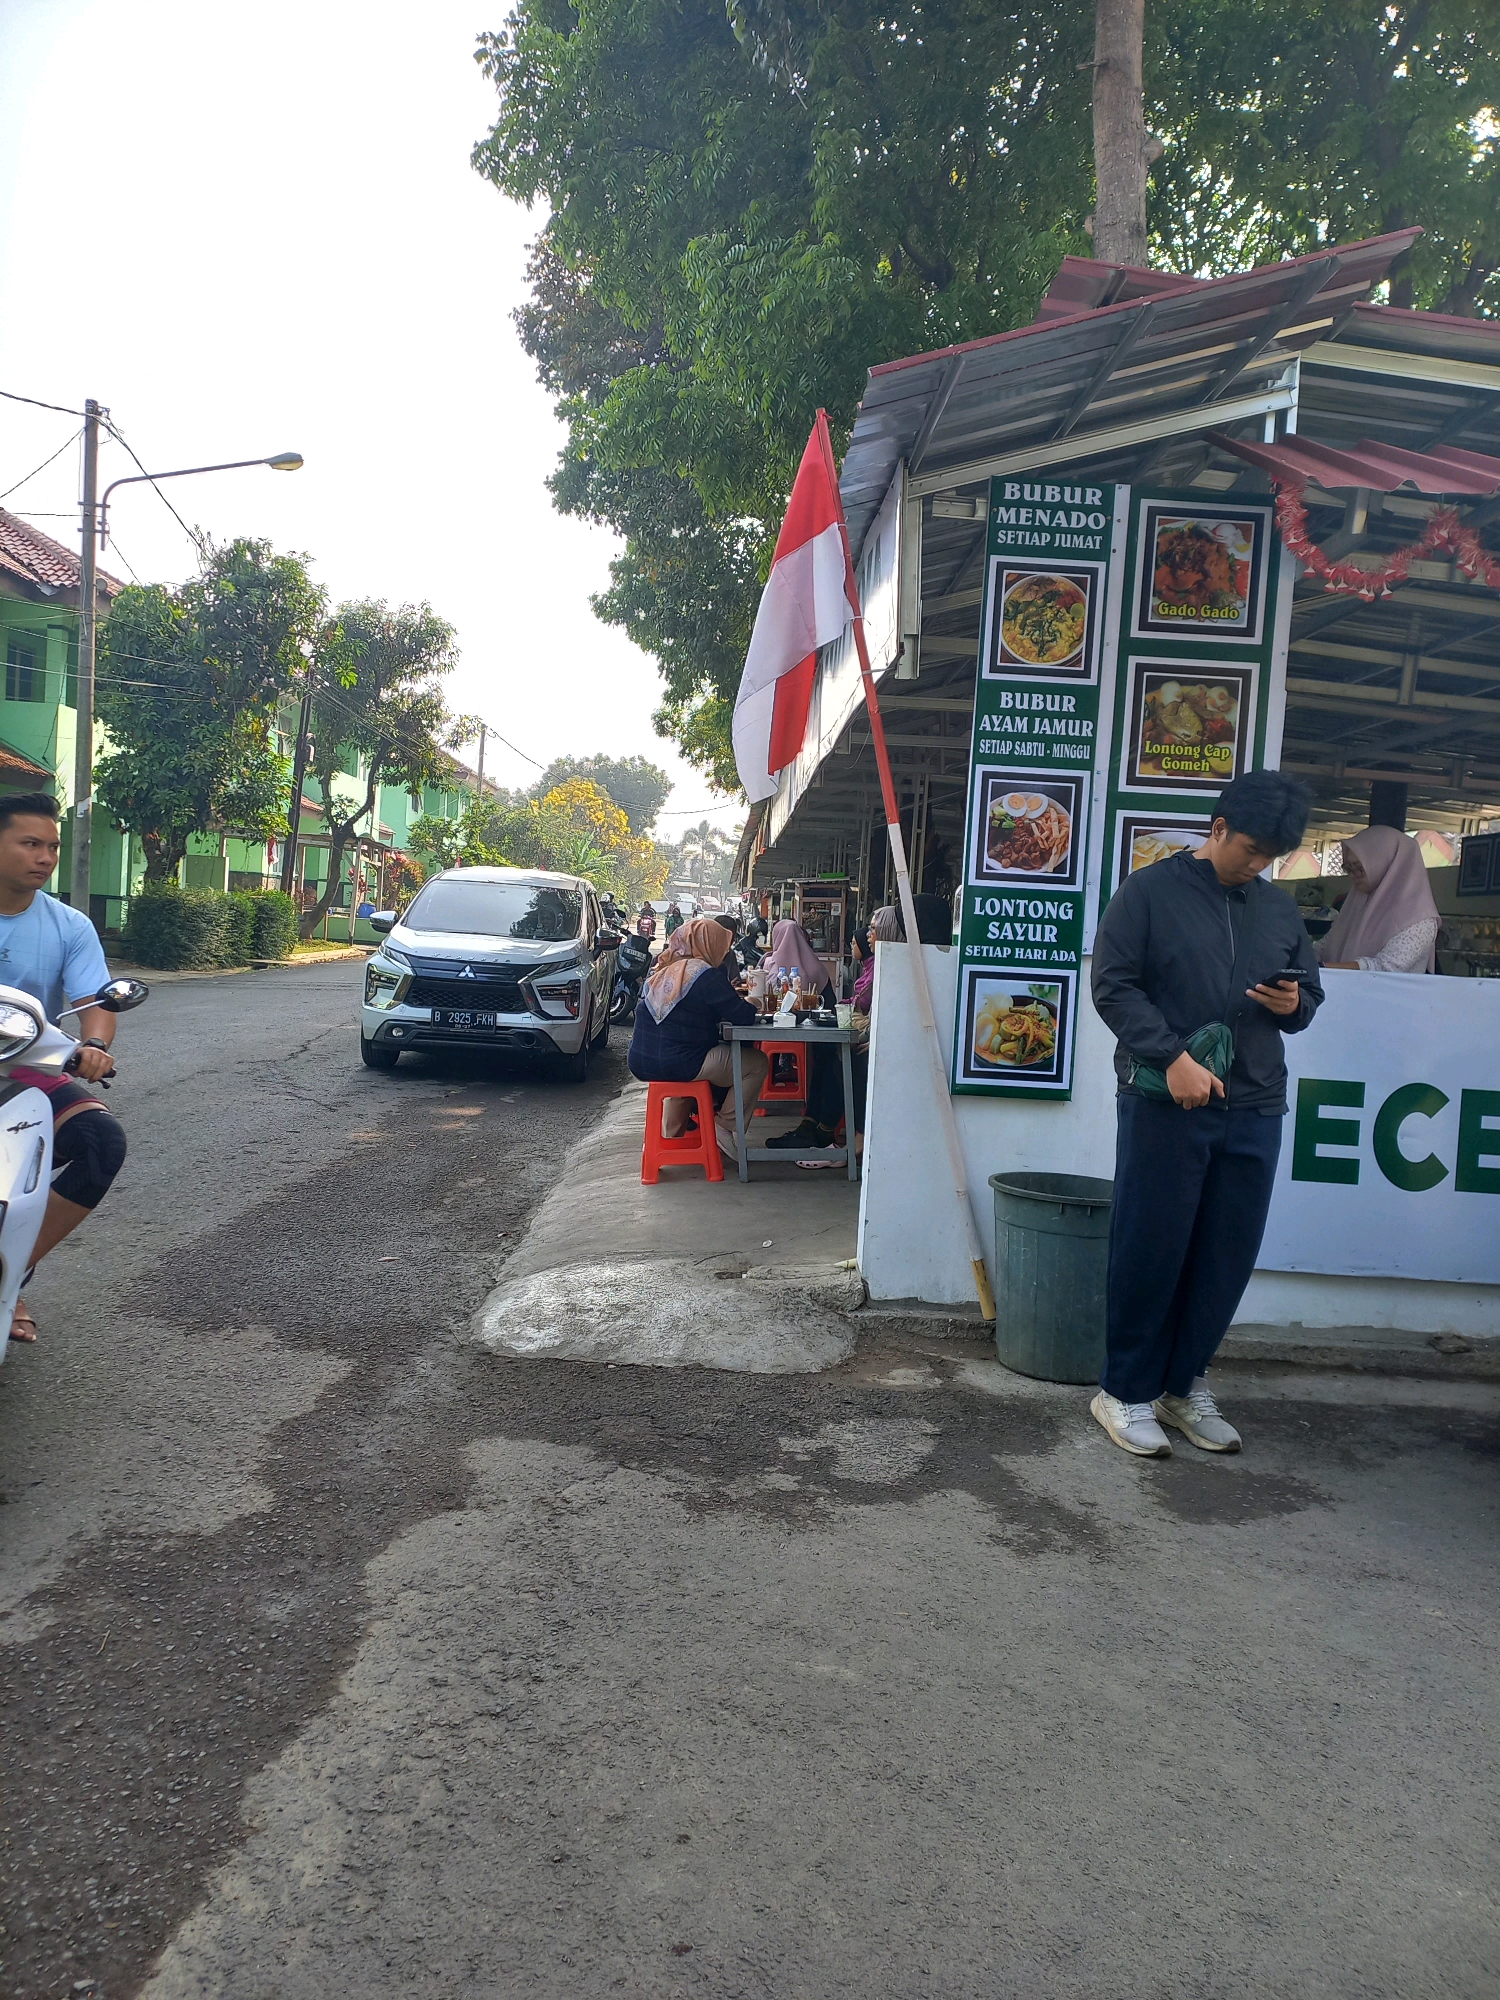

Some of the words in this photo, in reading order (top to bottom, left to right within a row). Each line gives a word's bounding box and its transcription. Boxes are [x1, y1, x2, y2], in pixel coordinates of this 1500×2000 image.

[1003, 482, 1103, 506] BUBUR
[996, 506, 1106, 530] MENADO
[997, 529, 1051, 547] SETIAP
[1053, 533, 1103, 550] JUMAT
[1158, 602, 1197, 617] Gado
[1200, 604, 1240, 620] Gado
[1000, 691, 1076, 713] BUBUR
[979, 714, 1029, 734] AYAM
[1032, 717, 1094, 737] JAMUR
[979, 738, 1013, 755] SETIAP
[1014, 740, 1046, 757] SABTU
[1052, 743, 1091, 760] MINGGU
[1145, 740, 1201, 759] Lontong
[1204, 744, 1230, 760] Cap
[1161, 756, 1210, 772] Gomeh
[973, 896, 1074, 920] LONTONG
[986, 921, 1058, 943] SAYUR
[964, 944, 1012, 959] SETIAP
[1014, 947, 1048, 961] HARI
[1050, 949, 1077, 963] ADA
[434, 1011, 441, 1022] B
[448, 1012, 471, 1024] 2925
